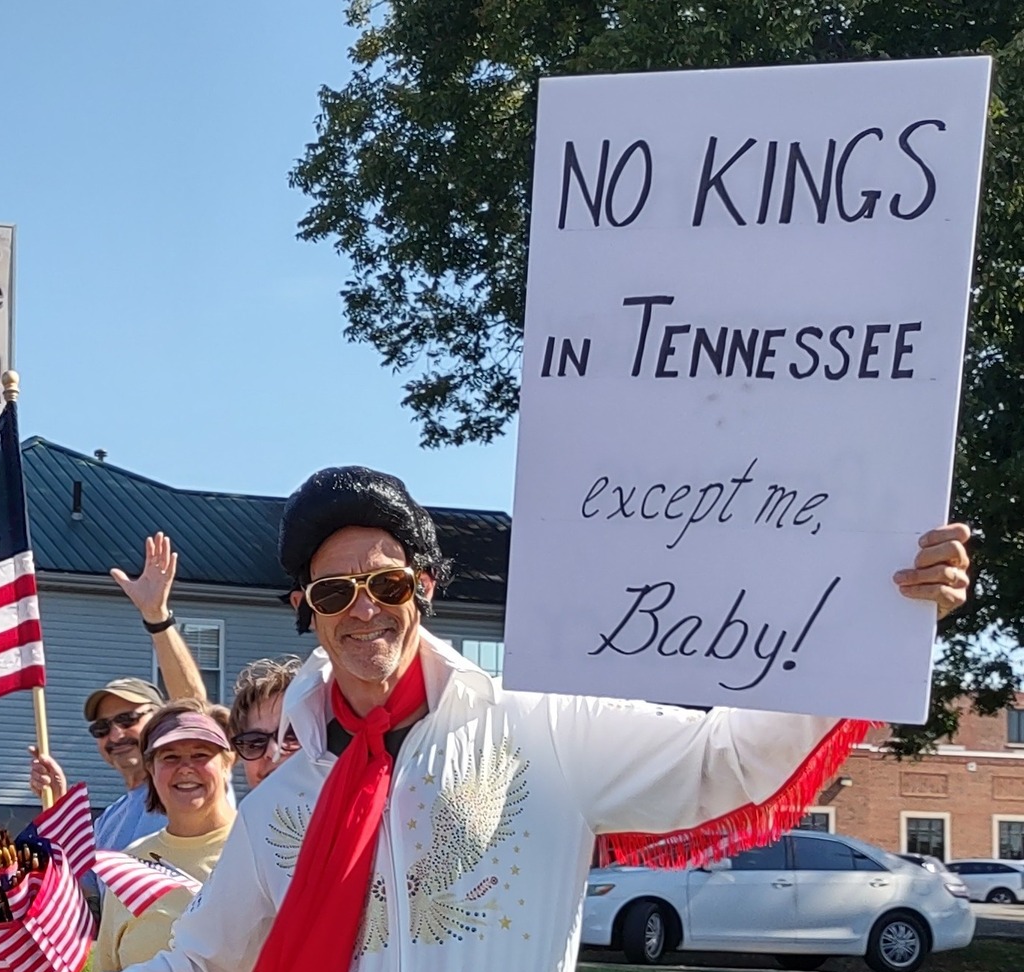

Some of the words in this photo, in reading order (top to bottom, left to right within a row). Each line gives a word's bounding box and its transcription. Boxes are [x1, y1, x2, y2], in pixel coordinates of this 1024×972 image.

[558, 139, 653, 229] NO
[692, 119, 946, 227] KINGS
[540, 337, 591, 378] IN
[622, 295, 922, 381] TENNESSEE
[581, 457, 758, 549] except
[754, 484, 829, 536] me,
[588, 576, 841, 690] Baby!
